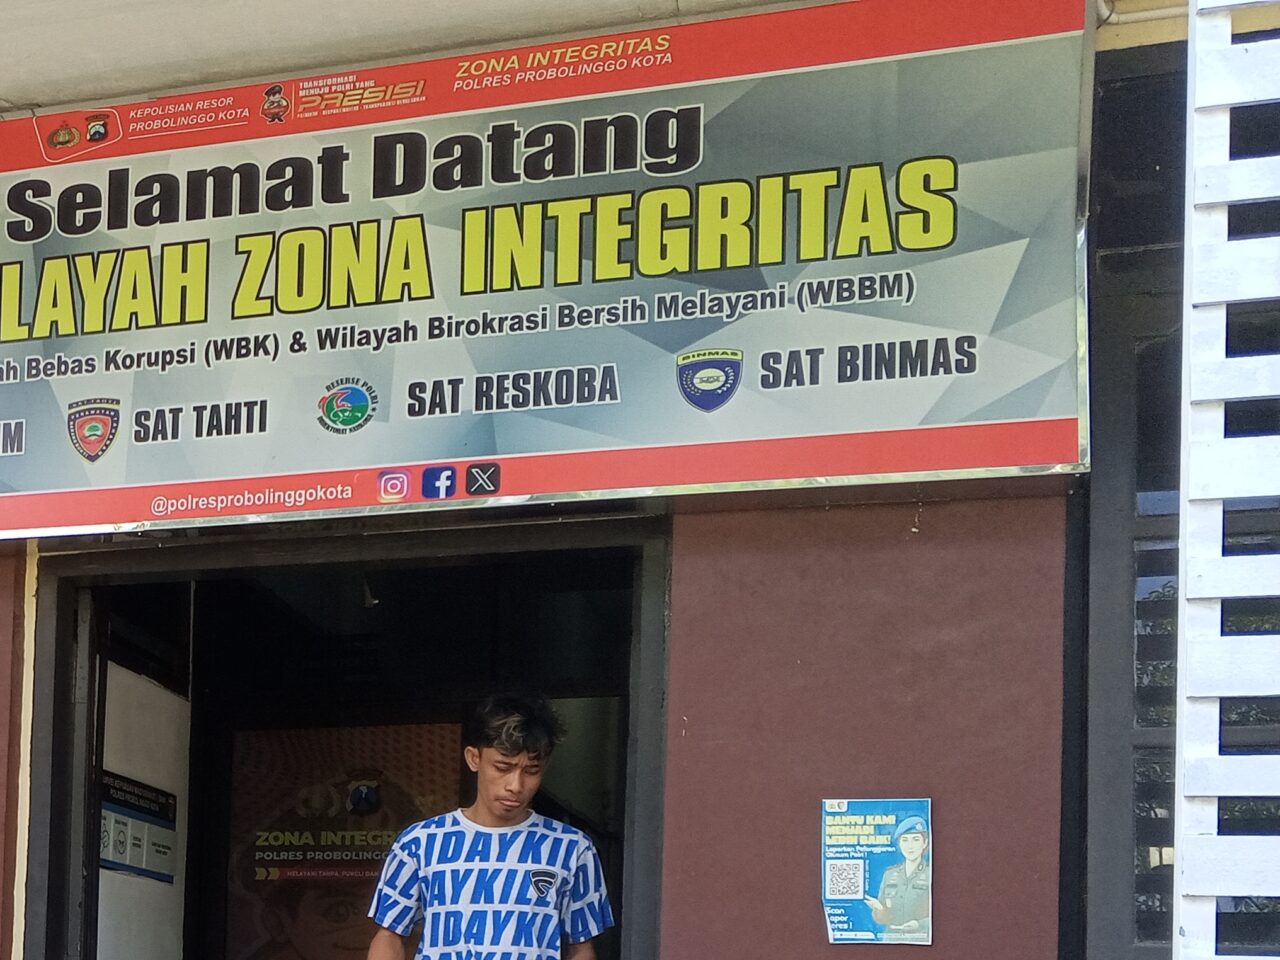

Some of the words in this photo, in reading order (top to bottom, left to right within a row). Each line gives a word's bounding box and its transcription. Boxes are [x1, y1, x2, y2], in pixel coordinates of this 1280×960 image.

[456, 55, 519, 77] ZONA
[526, 35, 671, 68] INTEGRITAS
[299, 75, 357, 89] TRANSFORMASI
[331, 83, 354, 93] POLRI
[355, 80, 376, 89] YANG
[453, 74, 511, 92] POLRES
[515, 59, 628, 84] PROBOLINGGO
[631, 53, 673, 69] KOTA
[129, 101, 194, 119] KEPOLISIAN
[197, 96, 234, 112] RESOR
[297, 80, 426, 112] PRESISI
[128, 113, 216, 132] PROBOLINGGO
[218, 107, 250, 123] KOTA
[6, 144, 350, 243] Selamat
[373, 103, 703, 199] Datang
[231, 215, 434, 320] ZONA
[460, 155, 959, 297] INTEGRITAS
[26, 352, 97, 380] Bebas
[104, 343, 197, 374] Korupsi
[204, 333, 280, 367] (WBK)
[288, 331, 307, 355] &
[317, 321, 419, 354] Wilayah
[427, 306, 549, 341] Birokrasi
[558, 300, 647, 329] Bersih
[655, 285, 787, 321] Melayani
[797, 273, 915, 313] (WBBM)
[681, 350, 739, 361] BINMAS
[760, 347, 824, 389] SAT
[837, 335, 977, 383] BINMAS
[408, 378, 464, 417] SAT
[475, 364, 618, 412] RESKOBA
[133, 408, 184, 444] SAT
[192, 400, 268, 438] TAHTI
[151, 485, 353, 515] @polresprobolinggokota
[255, 831, 315, 847] ZONA
[321, 830, 398, 846] INTEGR
[255, 851, 304, 861] POLRES
